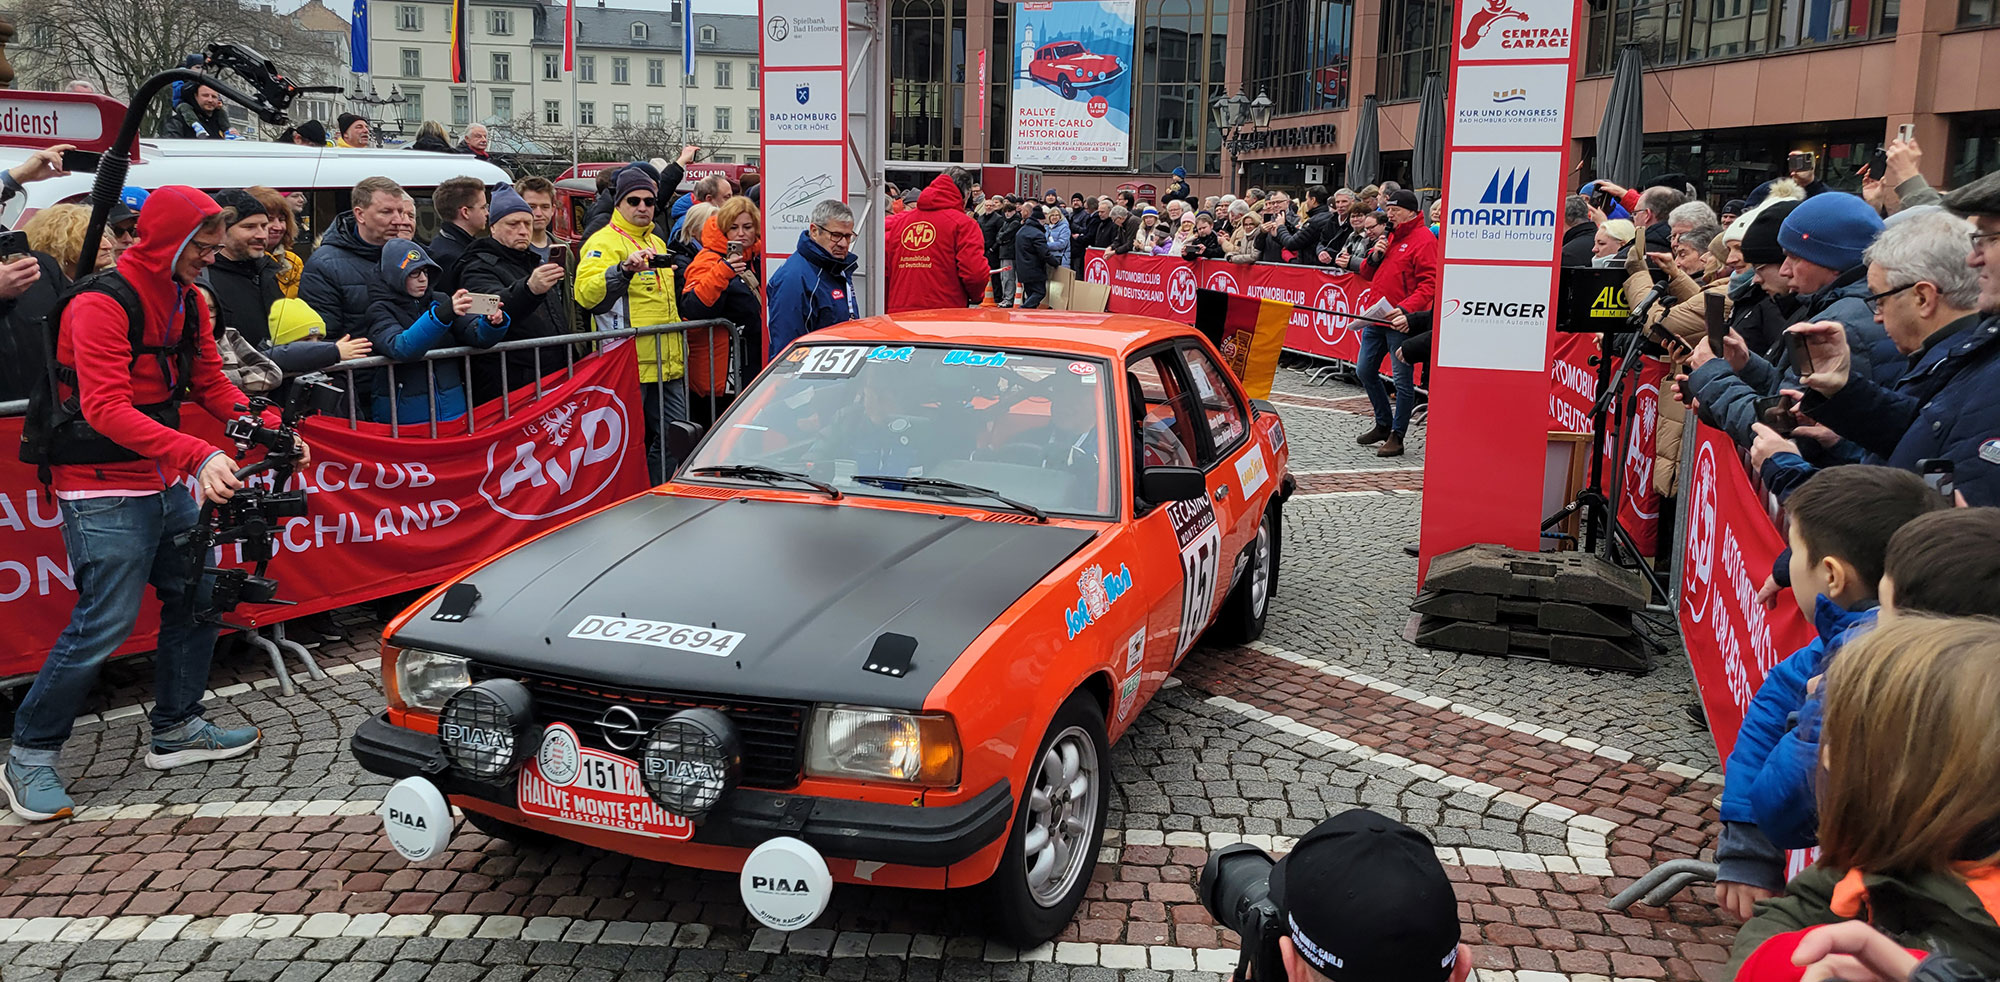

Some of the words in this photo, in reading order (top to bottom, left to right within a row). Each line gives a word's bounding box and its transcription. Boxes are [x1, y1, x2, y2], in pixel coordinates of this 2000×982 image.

[792, 17, 825, 25] Spielbank
[808, 25, 839, 33] Homburg
[1501, 28, 1569, 39] CENTRAL
[1501, 38, 1569, 49] GARAGE
[769, 113, 788, 121] BAD
[790, 113, 837, 121] HOMBURG
[1019, 108, 1056, 116] RALLYE
[1504, 109, 1558, 117] KONGRESS
[0, 106, 59, 136] dienst
[1019, 119, 1094, 128] MONTE-CARLO
[1018, 129, 1079, 138] HISTORIQUE
[781, 214, 810, 223] SCHRA
[1450, 208, 1555, 227] MARITIM
[1451, 229, 1478, 239] Hotel
[1482, 229, 1501, 240] Bad
[1504, 230, 1553, 242] Homburg
[1115, 269, 1161, 285] AUTOMOBILCLUB
[1111, 285, 1123, 296] VON
[1123, 288, 1165, 303] DEUTSCHLAND
[1246, 284, 1306, 305] AUTOMOBILCLUB
[1461, 301, 1546, 319] SENGER
[810, 349, 861, 373] 151
[576, 618, 627, 638] DC
[624, 623, 735, 652] 22694
[442, 723, 508, 750] PIAA
[583, 758, 618, 791] 151
[644, 757, 719, 784] PIAA
[522, 768, 571, 811] RALLYE
[389, 807, 428, 830] PIAA
[560, 809, 645, 832] HISTORIQUE
[752, 876, 810, 893] PIAA
[760, 910, 781, 922] SUPER
[782, 913, 806, 924] RACING
